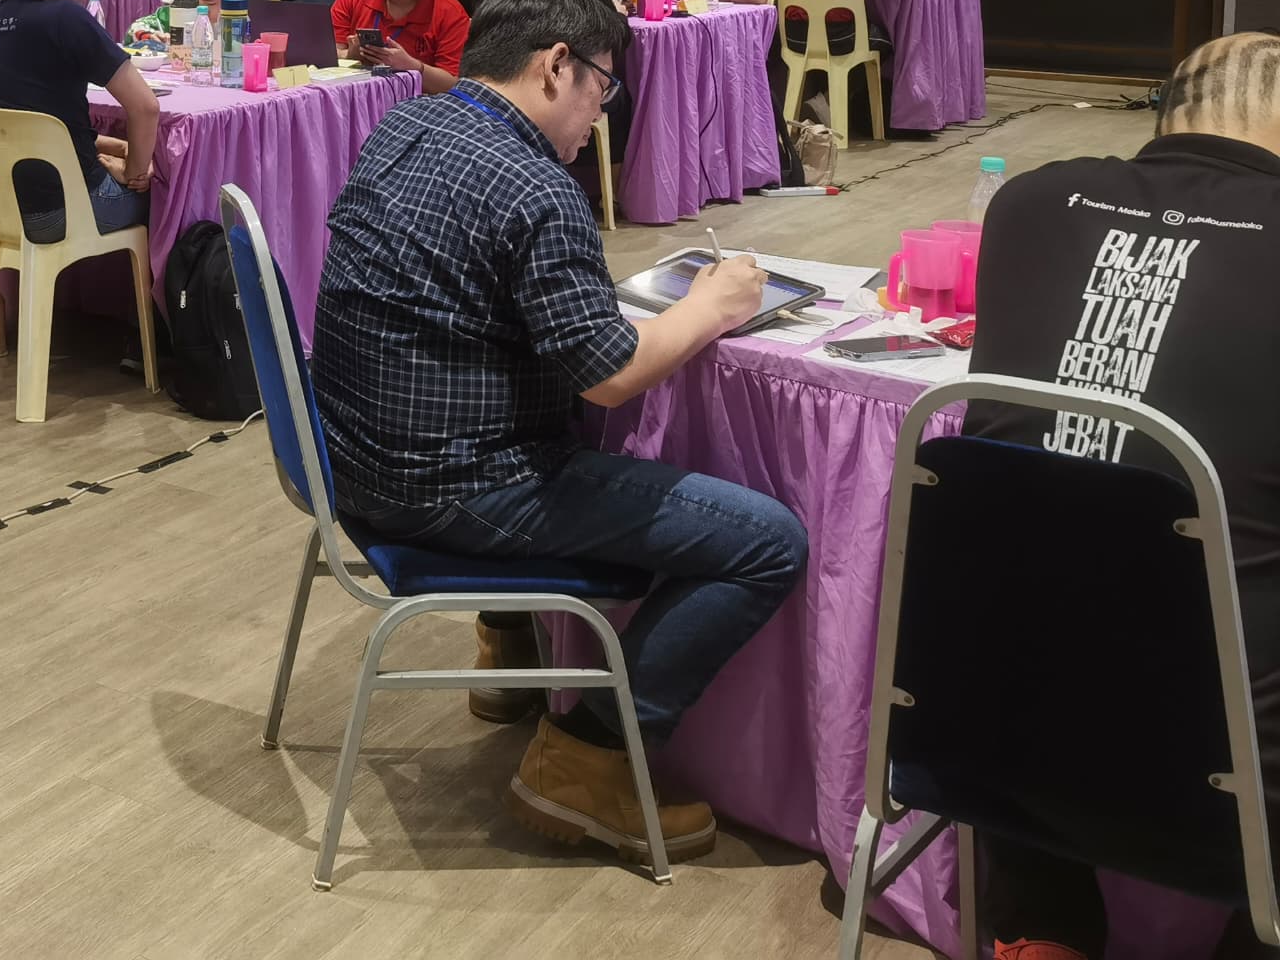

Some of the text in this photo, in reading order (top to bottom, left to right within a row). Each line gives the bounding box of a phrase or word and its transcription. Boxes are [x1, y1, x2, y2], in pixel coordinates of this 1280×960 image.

[1081, 197, 1116, 212] Tourism
[1117, 205, 1152, 218] Melaka
[1187, 215, 1264, 231] fabulousmelaka
[1094, 228, 1200, 279] BIJAK
[1084, 267, 1181, 305] LAKSANA
[1074, 292, 1173, 353] TUAH
[1057, 339, 1156, 393] BERANI
[1042, 410, 1135, 464] JEBAT
